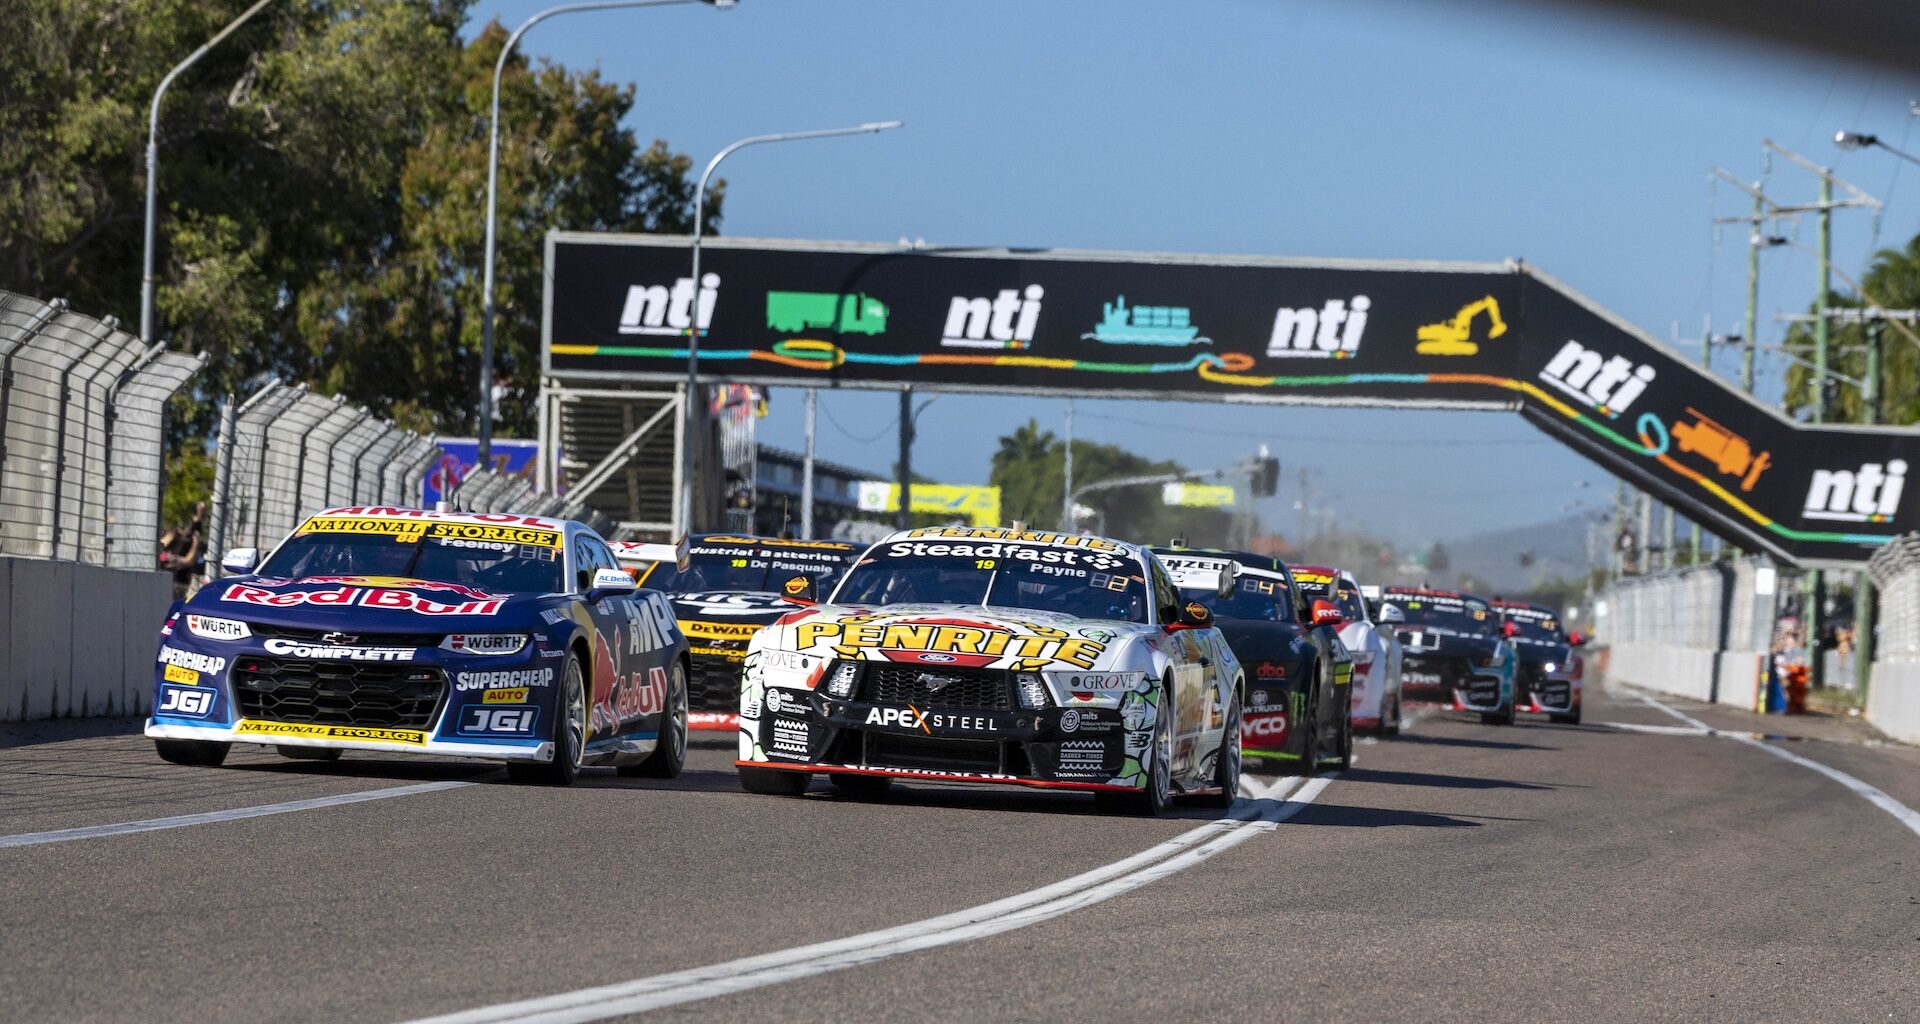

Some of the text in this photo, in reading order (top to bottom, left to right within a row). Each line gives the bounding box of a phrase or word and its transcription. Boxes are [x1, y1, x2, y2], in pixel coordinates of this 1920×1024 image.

[620, 271, 721, 329] nti
[943, 283, 1044, 341] nti
[1267, 294, 1371, 352] nti
[1543, 338, 1656, 414] nti
[1803, 458, 1908, 516] nti
[304, 519, 552, 545] NATIONAL STORAGE
[395, 534, 419, 544] 88
[907, 527, 1116, 552] PENRITE
[440, 537, 515, 553] Feeney
[689, 546, 841, 562] dustrial Batteries
[887, 542, 1079, 566] Steadfast
[731, 559, 833, 574] 18 De Pasquale
[974, 560, 996, 571] 19
[1029, 563, 1087, 578] Payne
[598, 575, 635, 583] ACDelco
[1107, 575, 1130, 592] 2
[1258, 580, 1274, 595] 4
[220, 584, 362, 607] Red
[359, 587, 510, 616] Bull
[264, 638, 417, 661] COMPLETE
[796, 622, 1107, 671] PENRITE
[762, 650, 797, 669] ROVE
[169, 669, 195, 681] AUTO
[456, 667, 553, 692] SUPERCHEAP
[1083, 674, 1133, 689] GROVE
[160, 688, 212, 714] JGI
[487, 690, 524, 700] AUTO
[632, 667, 667, 717] Bull
[464, 709, 533, 732] JGI
[864, 705, 998, 734] APEX STEEL
[1081, 711, 1098, 720] mits
[1241, 716, 1286, 737] YCO
[239, 721, 421, 743] NATIONAL STORAGE
